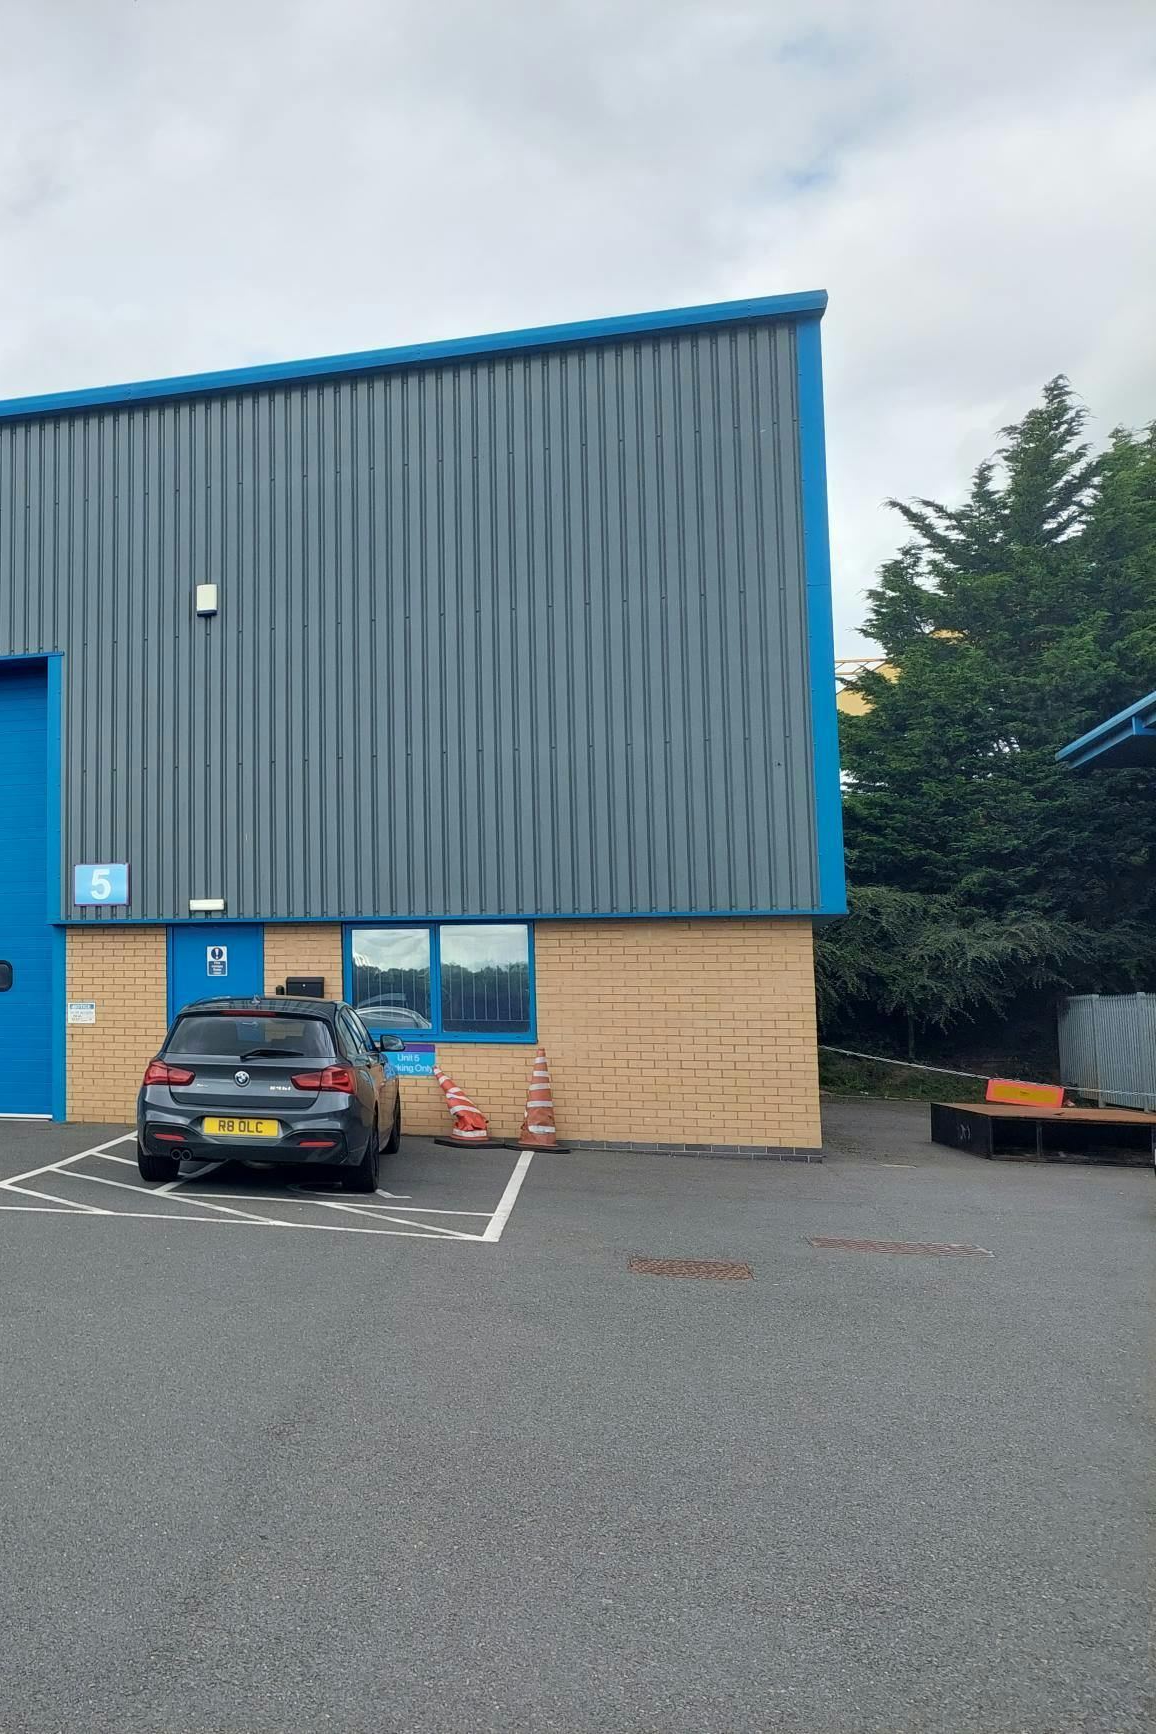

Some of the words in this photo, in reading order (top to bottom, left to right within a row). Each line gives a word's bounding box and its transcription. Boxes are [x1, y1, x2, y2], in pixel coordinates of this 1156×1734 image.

[91, 868, 112, 900] 5
[397, 1054, 413, 1062] Unit
[414, 1054, 421, 1062] 5
[395, 1064, 414, 1073] king
[415, 1064, 432, 1074] Only
[218, 1120, 235, 1132] R8
[238, 1121, 263, 1134] OLC
